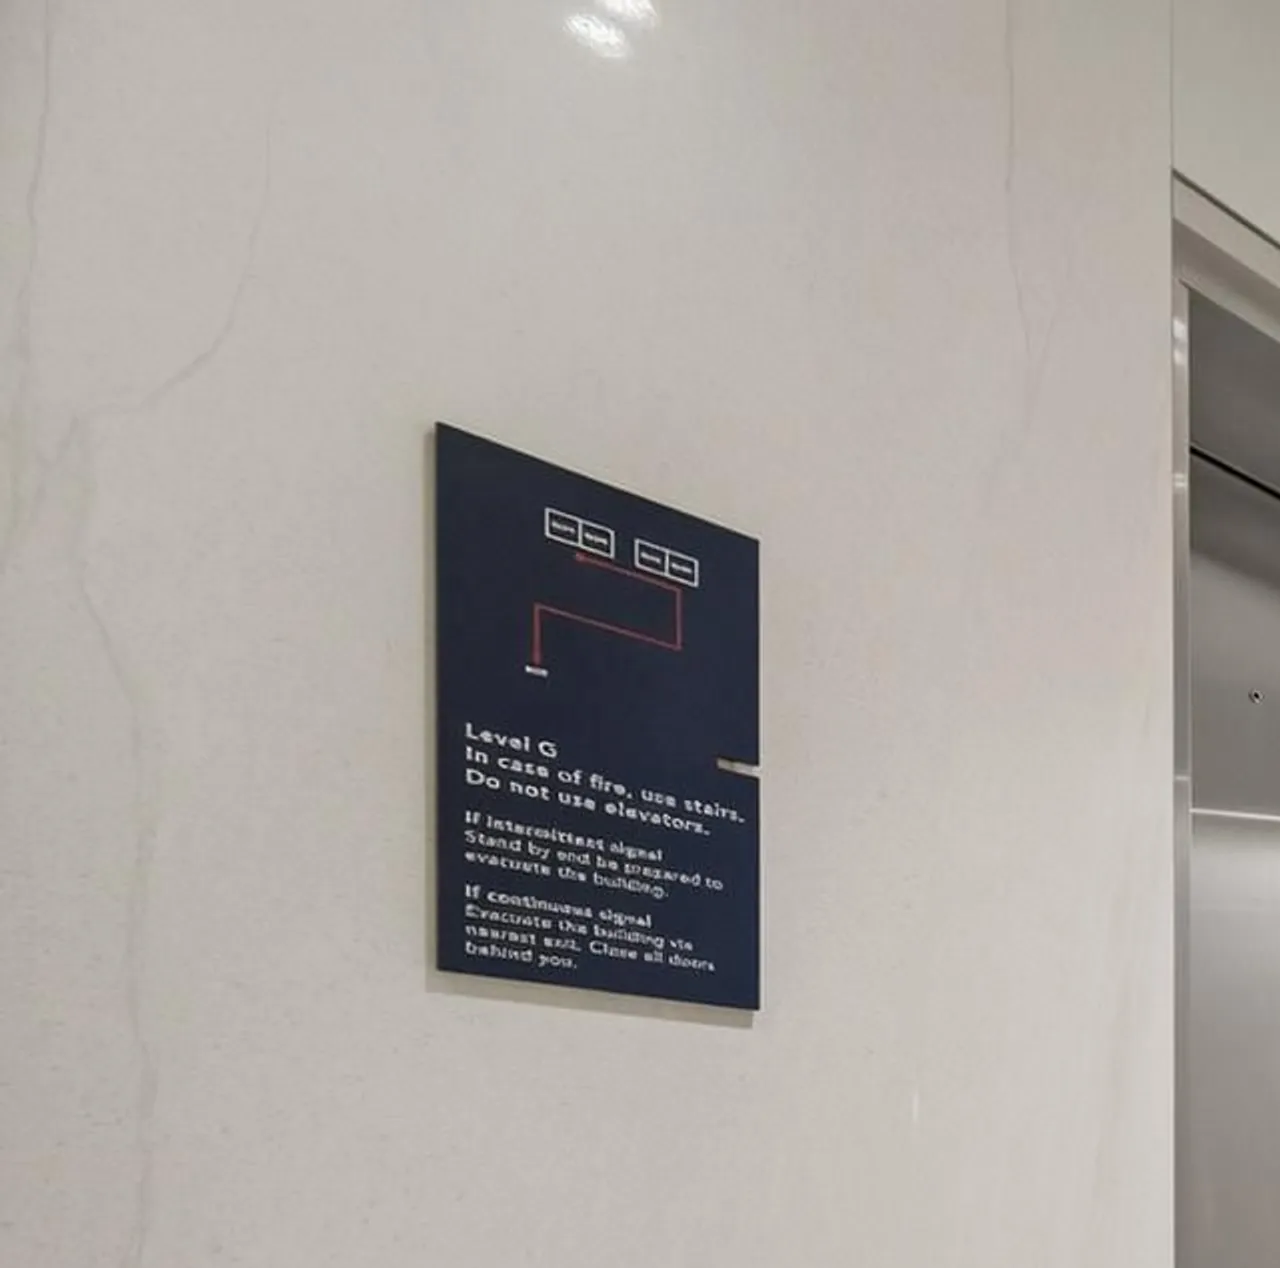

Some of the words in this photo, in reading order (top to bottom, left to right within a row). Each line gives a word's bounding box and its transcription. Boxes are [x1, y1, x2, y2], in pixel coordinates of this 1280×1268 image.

[465, 722, 530, 752] Level
[538, 740, 557, 758] G
[466, 745, 488, 764] In
[498, 757, 549, 778] case
[558, 769, 582, 785] of
[641, 789, 676, 807] use
[684, 799, 745, 823] stairs.
[465, 810, 480, 824] If
[466, 768, 500, 789] Do
[510, 780, 550, 801] not
[558, 791, 596, 811] use
[605, 802, 711, 836] elevators.
[464, 830, 521, 852] Stand
[527, 841, 551, 859] by
[596, 855, 619, 871] be
[705, 878, 723, 891] to
[465, 852, 551, 876] evacuate
[558, 867, 587, 881] the
[465, 884, 480, 899] If
[465, 903, 552, 929] Evacuate
[559, 920, 587, 935] the
[465, 925, 536, 945] nearest
[589, 940, 638, 960] Close
[668, 953, 715, 971] doors
[465, 941, 533, 962] behind
[539, 954, 577, 969] you.
